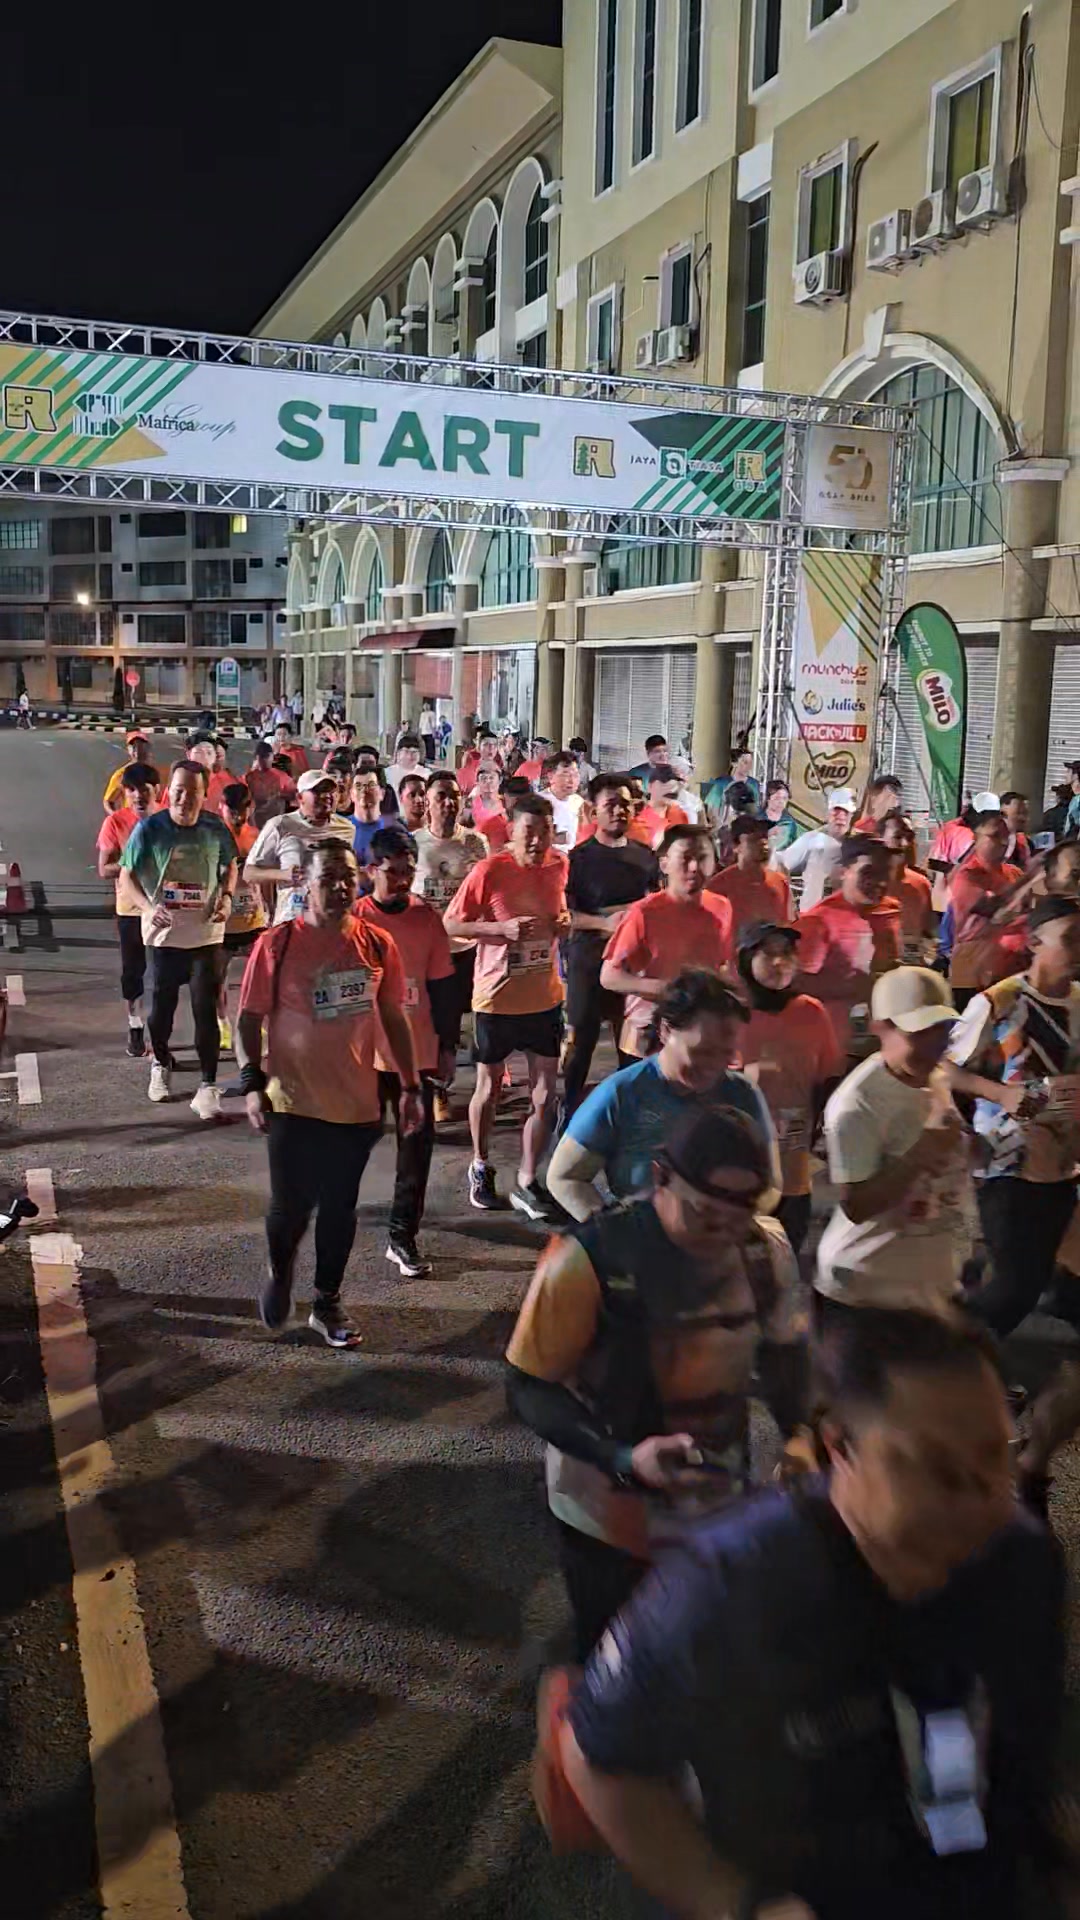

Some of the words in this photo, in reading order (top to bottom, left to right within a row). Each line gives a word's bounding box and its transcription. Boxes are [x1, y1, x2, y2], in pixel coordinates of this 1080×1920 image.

[138, 414, 196, 431] Mafrica
[275, 400, 540, 478] START
[630, 455, 657, 465] JAYA
[827, 698, 866, 711] Julie's
[925, 675, 951, 725] MILO
[314, 989, 329, 1004] 2A
[341, 982, 366, 998] 2397
